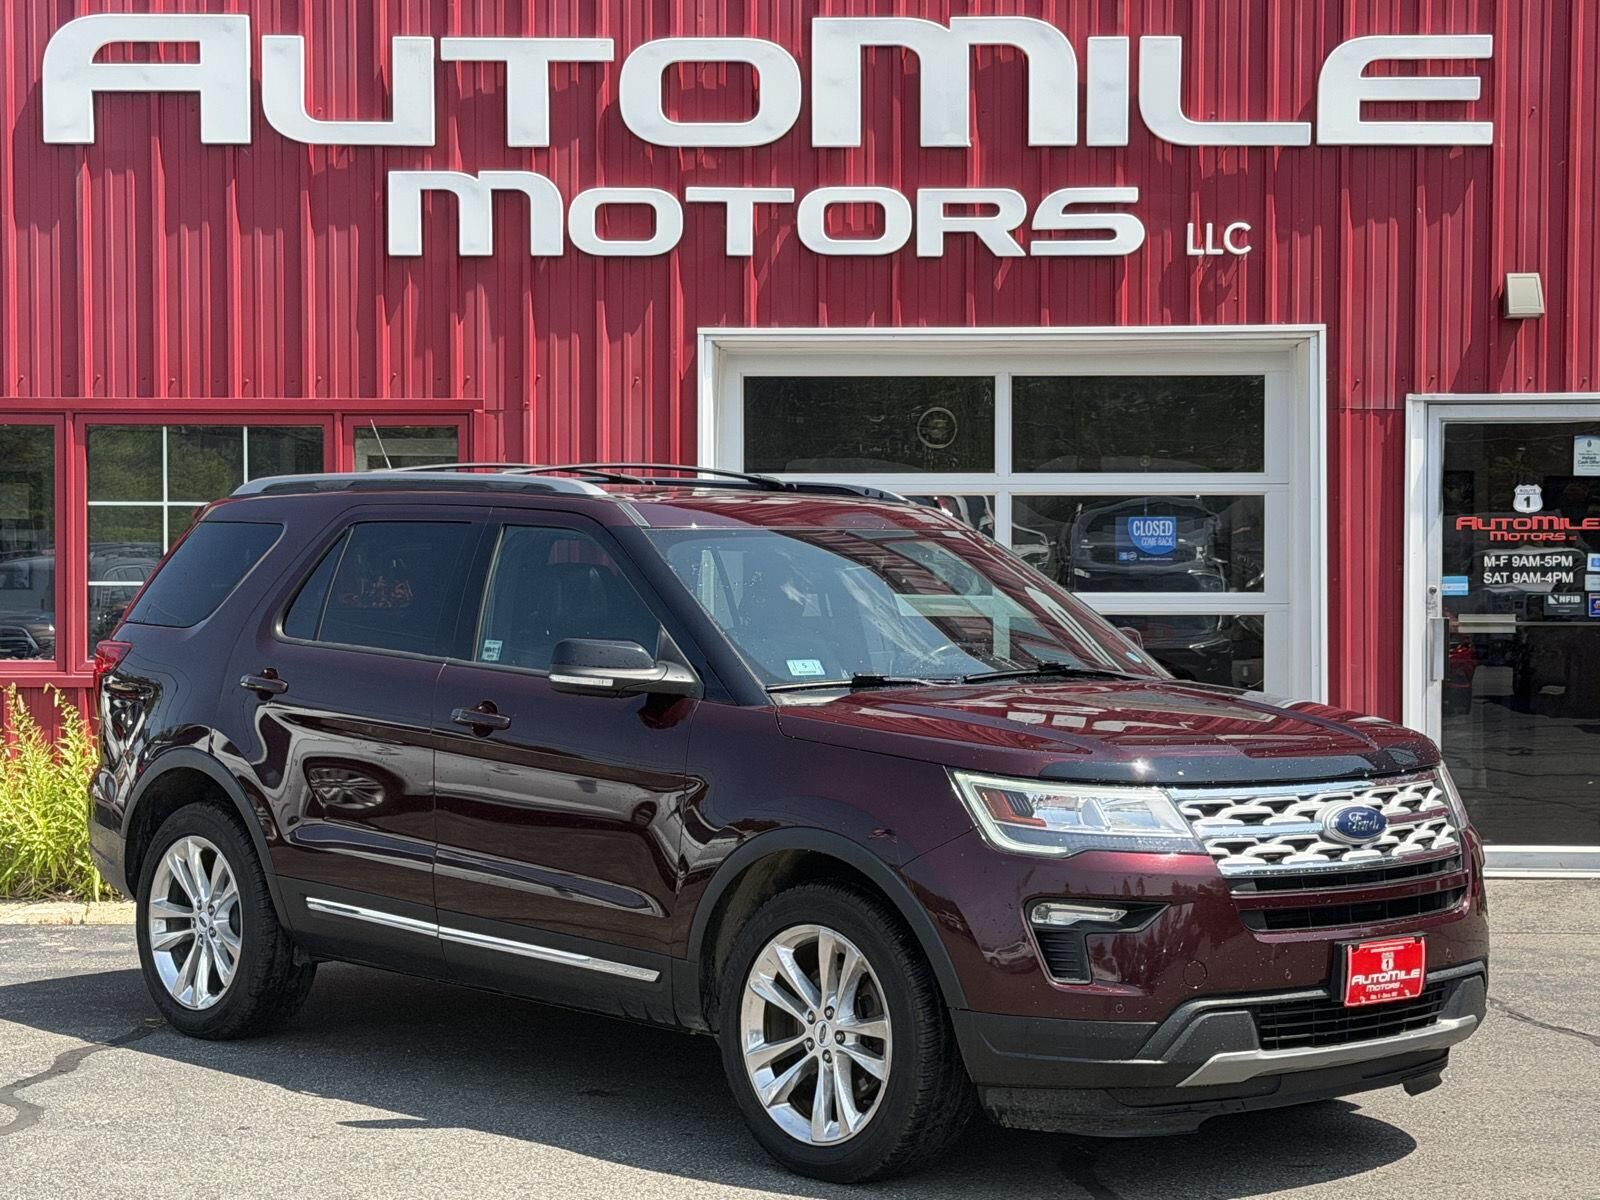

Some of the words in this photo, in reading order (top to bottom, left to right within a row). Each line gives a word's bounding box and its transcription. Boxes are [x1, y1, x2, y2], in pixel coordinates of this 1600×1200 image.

[42, 13, 1494, 149] AUTOMILE
[387, 169, 1146, 258] MOTORS
[1186, 222, 1252, 257] LLC
[1523, 496, 1531, 508] 1
[1133, 520, 1173, 536] CLOSED
[1456, 515, 1600, 531] AUTOMILE
[1141, 536, 1158, 546] COME
[1157, 536, 1173, 546] BACK
[1489, 531, 1566, 541] MOTORS
[1483, 555, 1508, 567] M-F
[1512, 555, 1573, 567] 9AM-5PM
[1483, 572, 1510, 584] SAT
[1512, 572, 1574, 584] 9AM-4PM
[1348, 811, 1379, 831] Ford
[1385, 959, 1390, 969] 1
[1351, 968, 1421, 985] AUTOMILE
[1366, 982, 1400, 992] MOTORS
